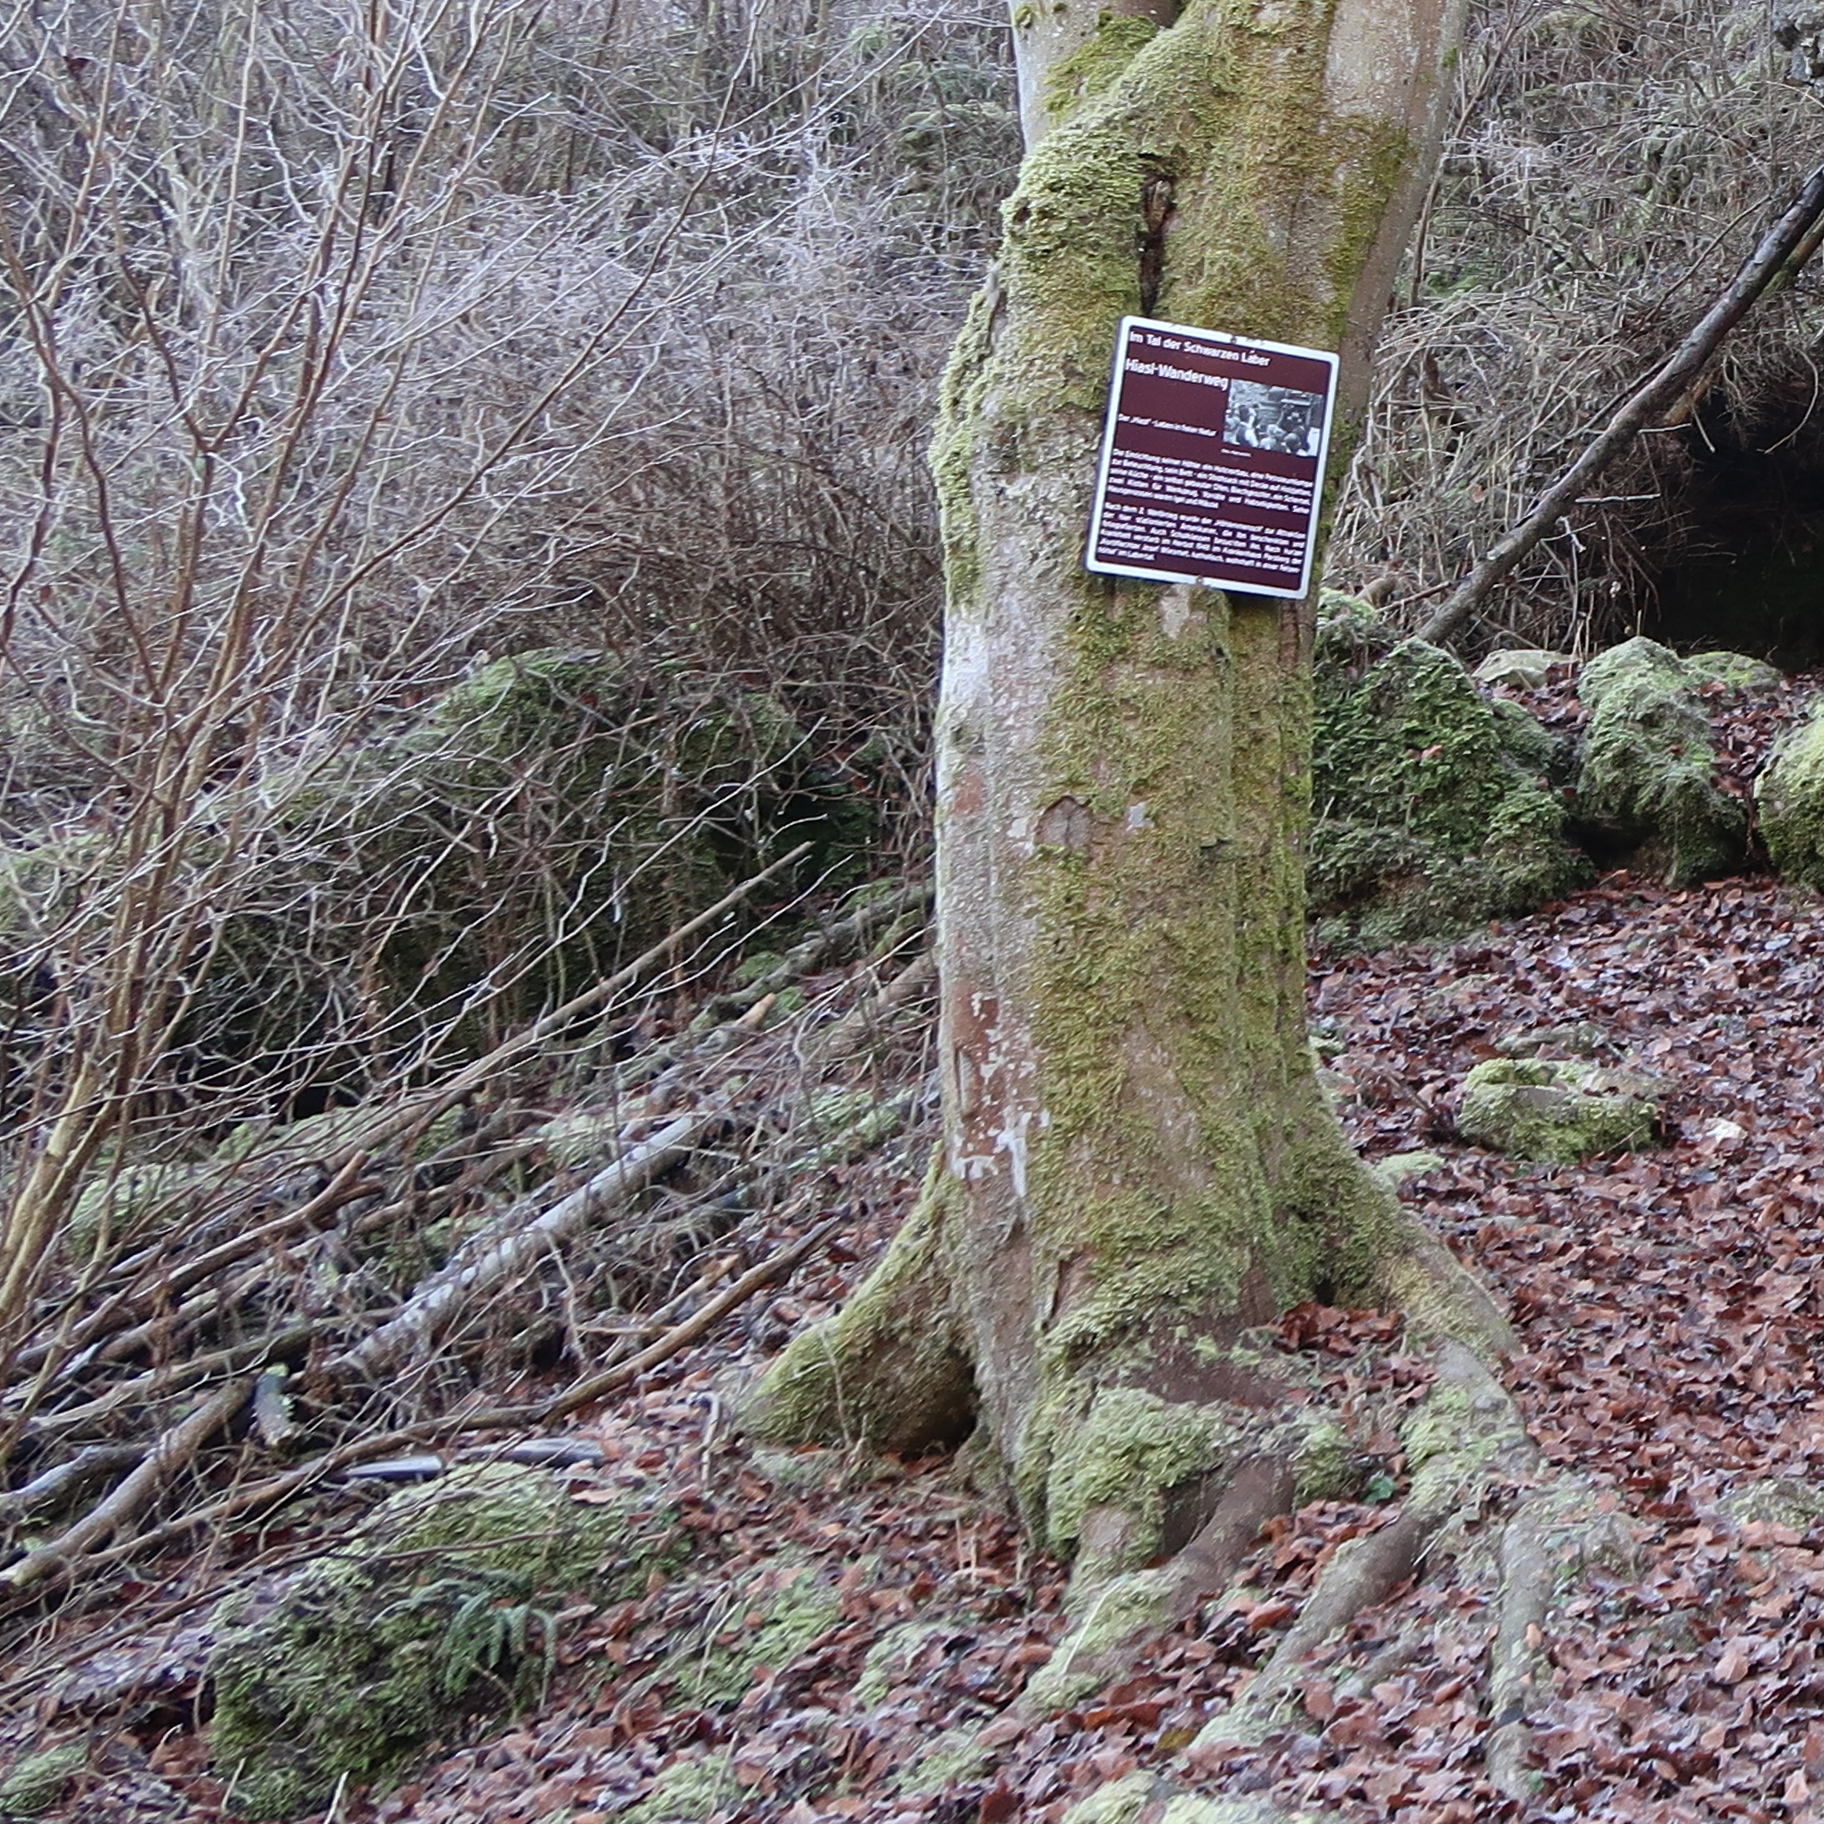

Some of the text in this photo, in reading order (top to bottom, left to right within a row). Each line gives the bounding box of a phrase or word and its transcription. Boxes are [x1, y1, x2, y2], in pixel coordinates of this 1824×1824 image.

[1129, 331, 1143, 343] Im
[1146, 334, 1161, 346] Tal
[1163, 338, 1181, 349] der
[1183, 341, 1239, 360] Schwarzen
[1125, 357, 1228, 391] Hiasl-Wanderweg
